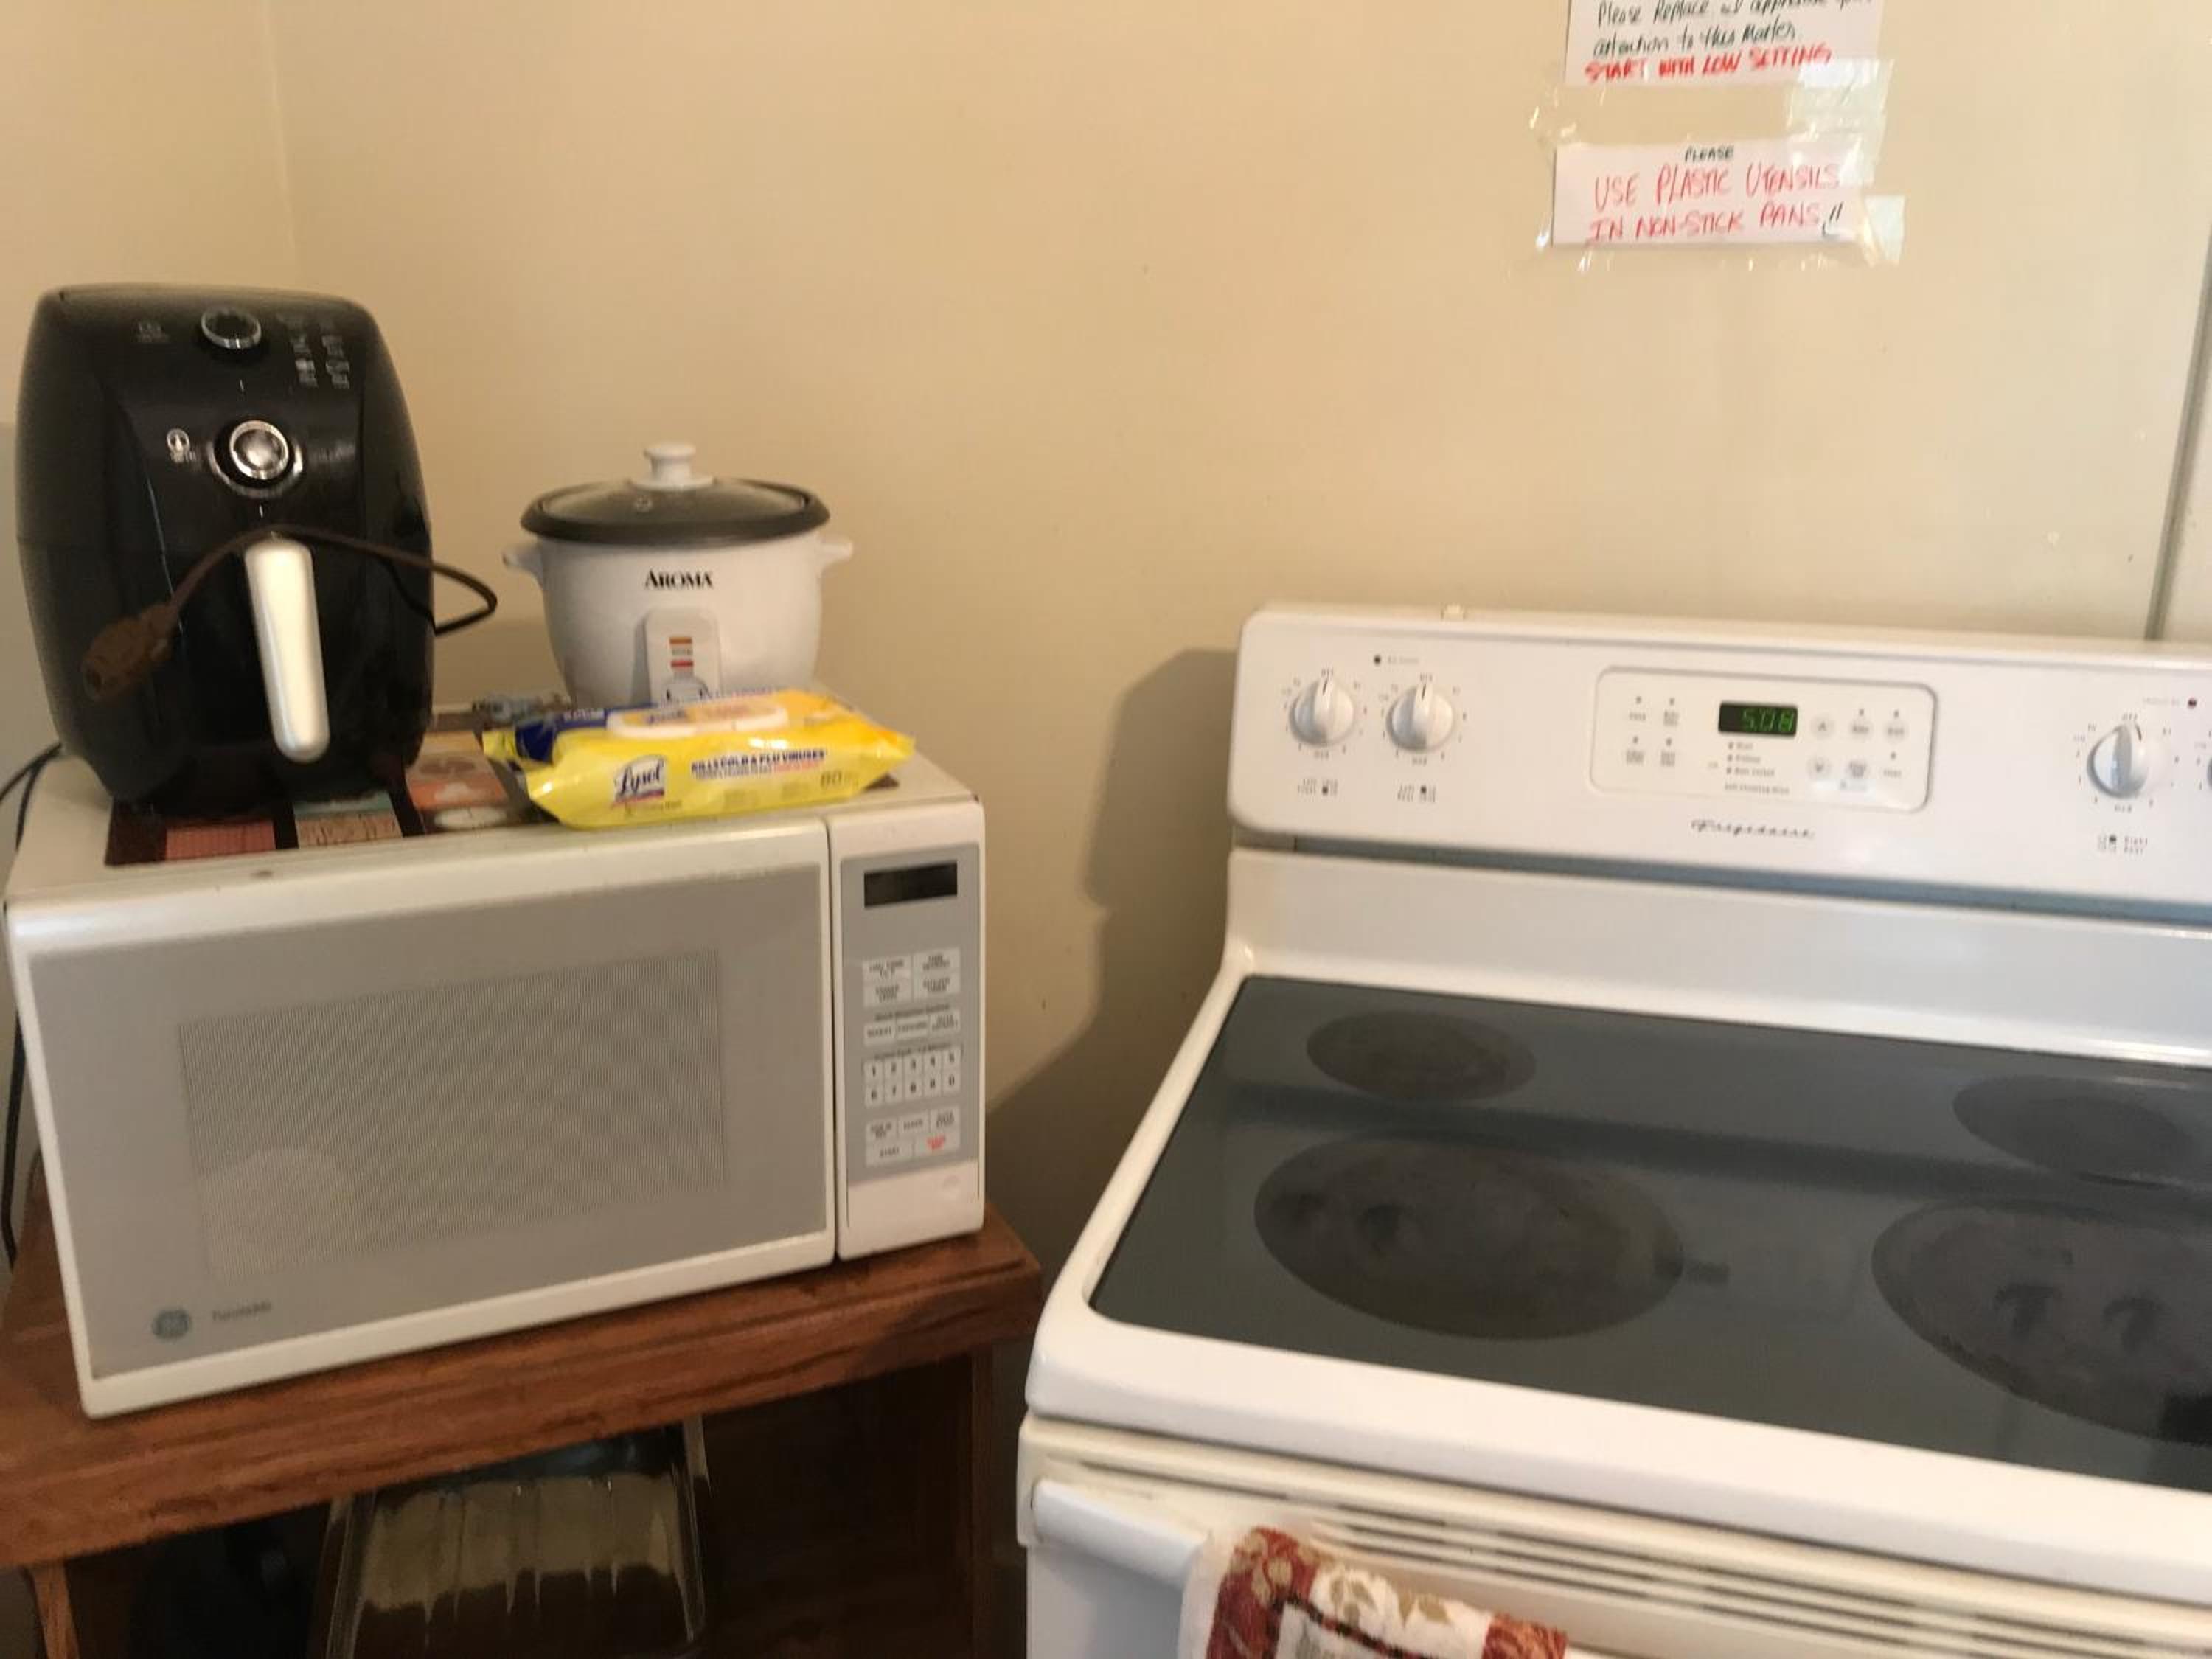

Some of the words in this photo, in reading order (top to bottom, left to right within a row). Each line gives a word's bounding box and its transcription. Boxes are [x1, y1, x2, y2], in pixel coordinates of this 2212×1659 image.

[1677, 24, 1694, 52] to
[1700, 23, 1735, 47] this
[1585, 57, 1647, 83] START
[1658, 55, 1695, 77] WITH
[1703, 50, 1742, 76] LOW
[1749, 42, 1832, 69] SETTING
[1685, 145, 1734, 162] PLEASE
[1595, 170, 1640, 212] USE
[1656, 162, 1730, 206] PLASTIC
[1745, 162, 1840, 198] UTENSILS
[1589, 215, 1623, 240] IN
[616, 758, 663, 797] Lysol
